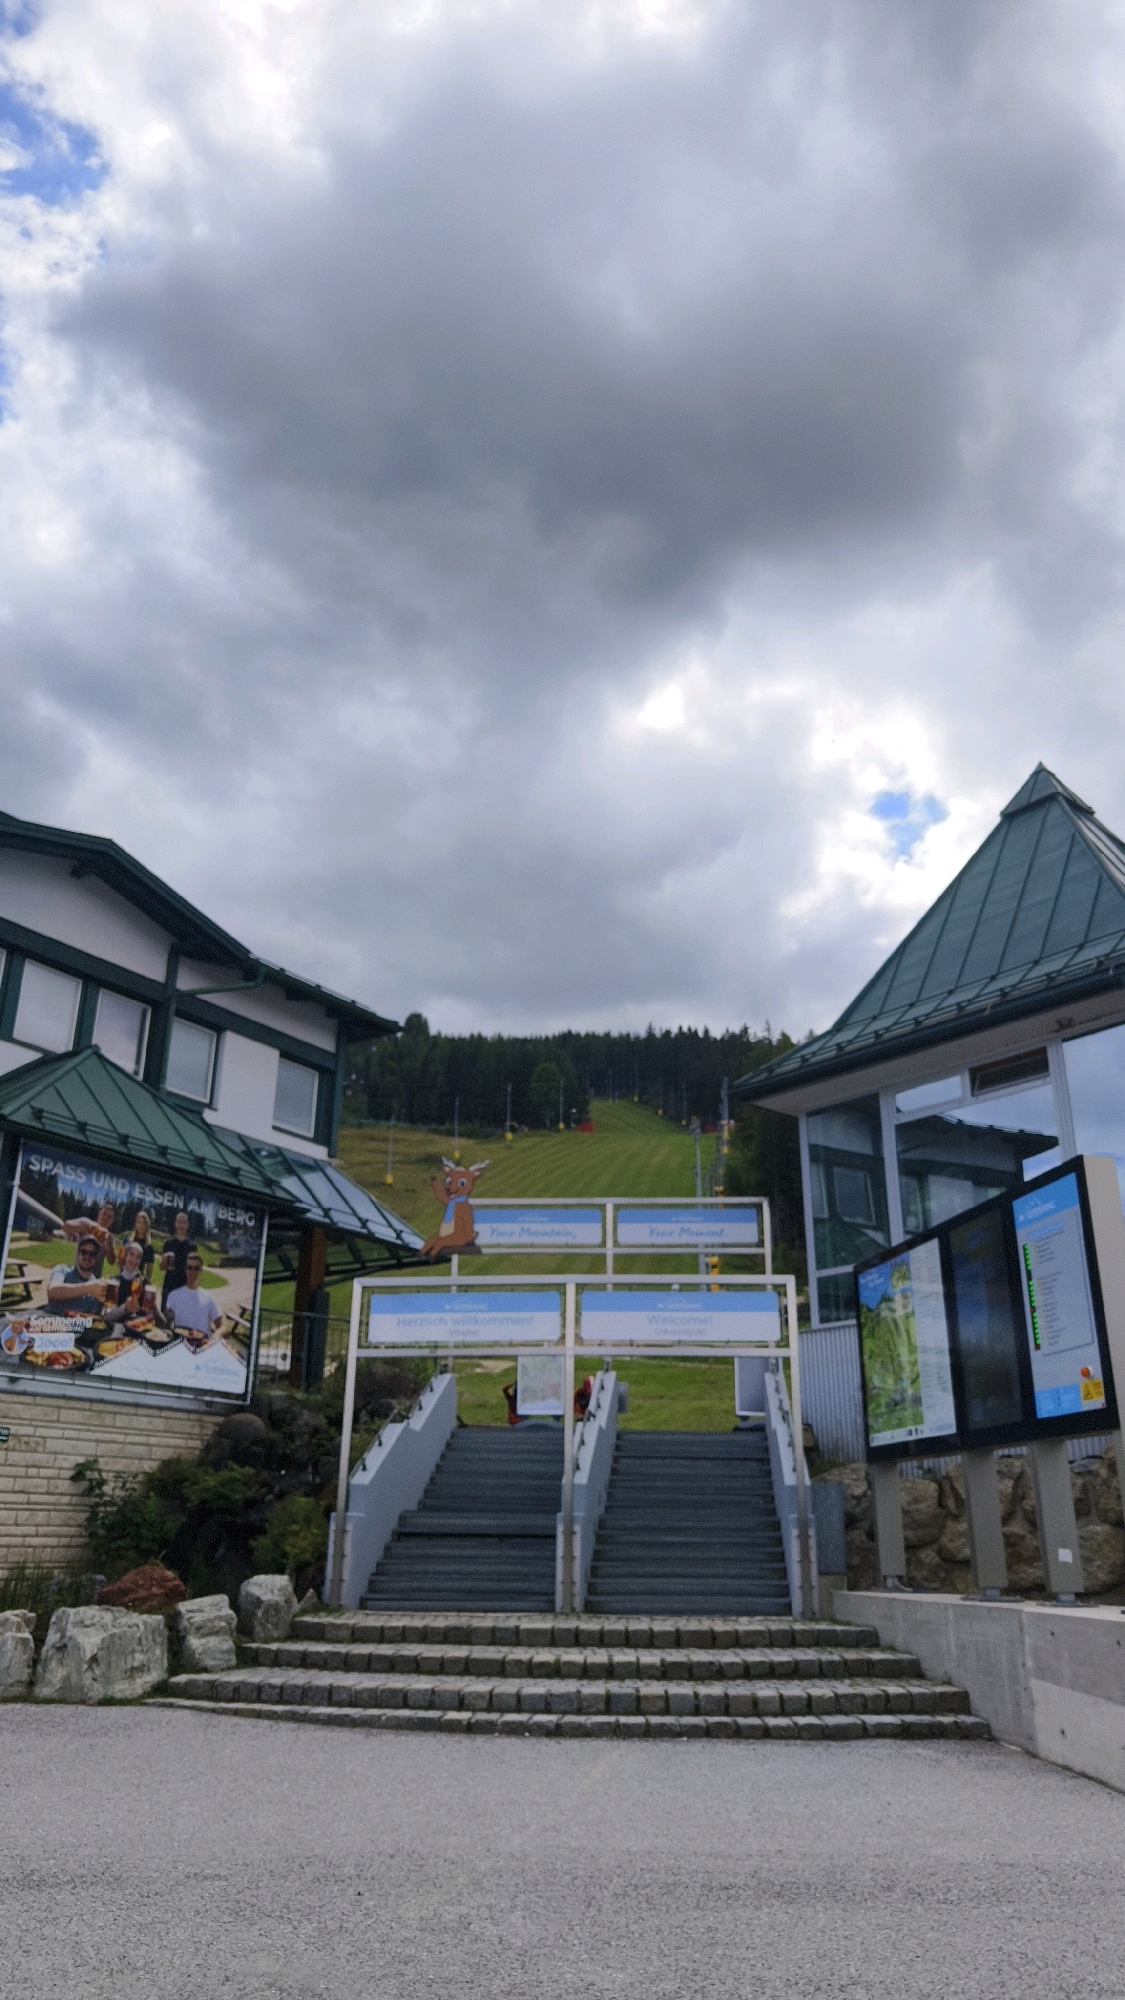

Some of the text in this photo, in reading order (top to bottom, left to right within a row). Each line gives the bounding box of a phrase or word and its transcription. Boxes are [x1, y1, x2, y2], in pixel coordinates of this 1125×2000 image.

[29, 1153, 256, 1228] SPASS UND ESSEN AM BERG
[489, 1226, 516, 1238] Your
[648, 1226, 728, 1238] Your Moment.
[396, 1315, 534, 1327] Herzlich willkommen!
[646, 1314, 713, 1326] Welcome!
